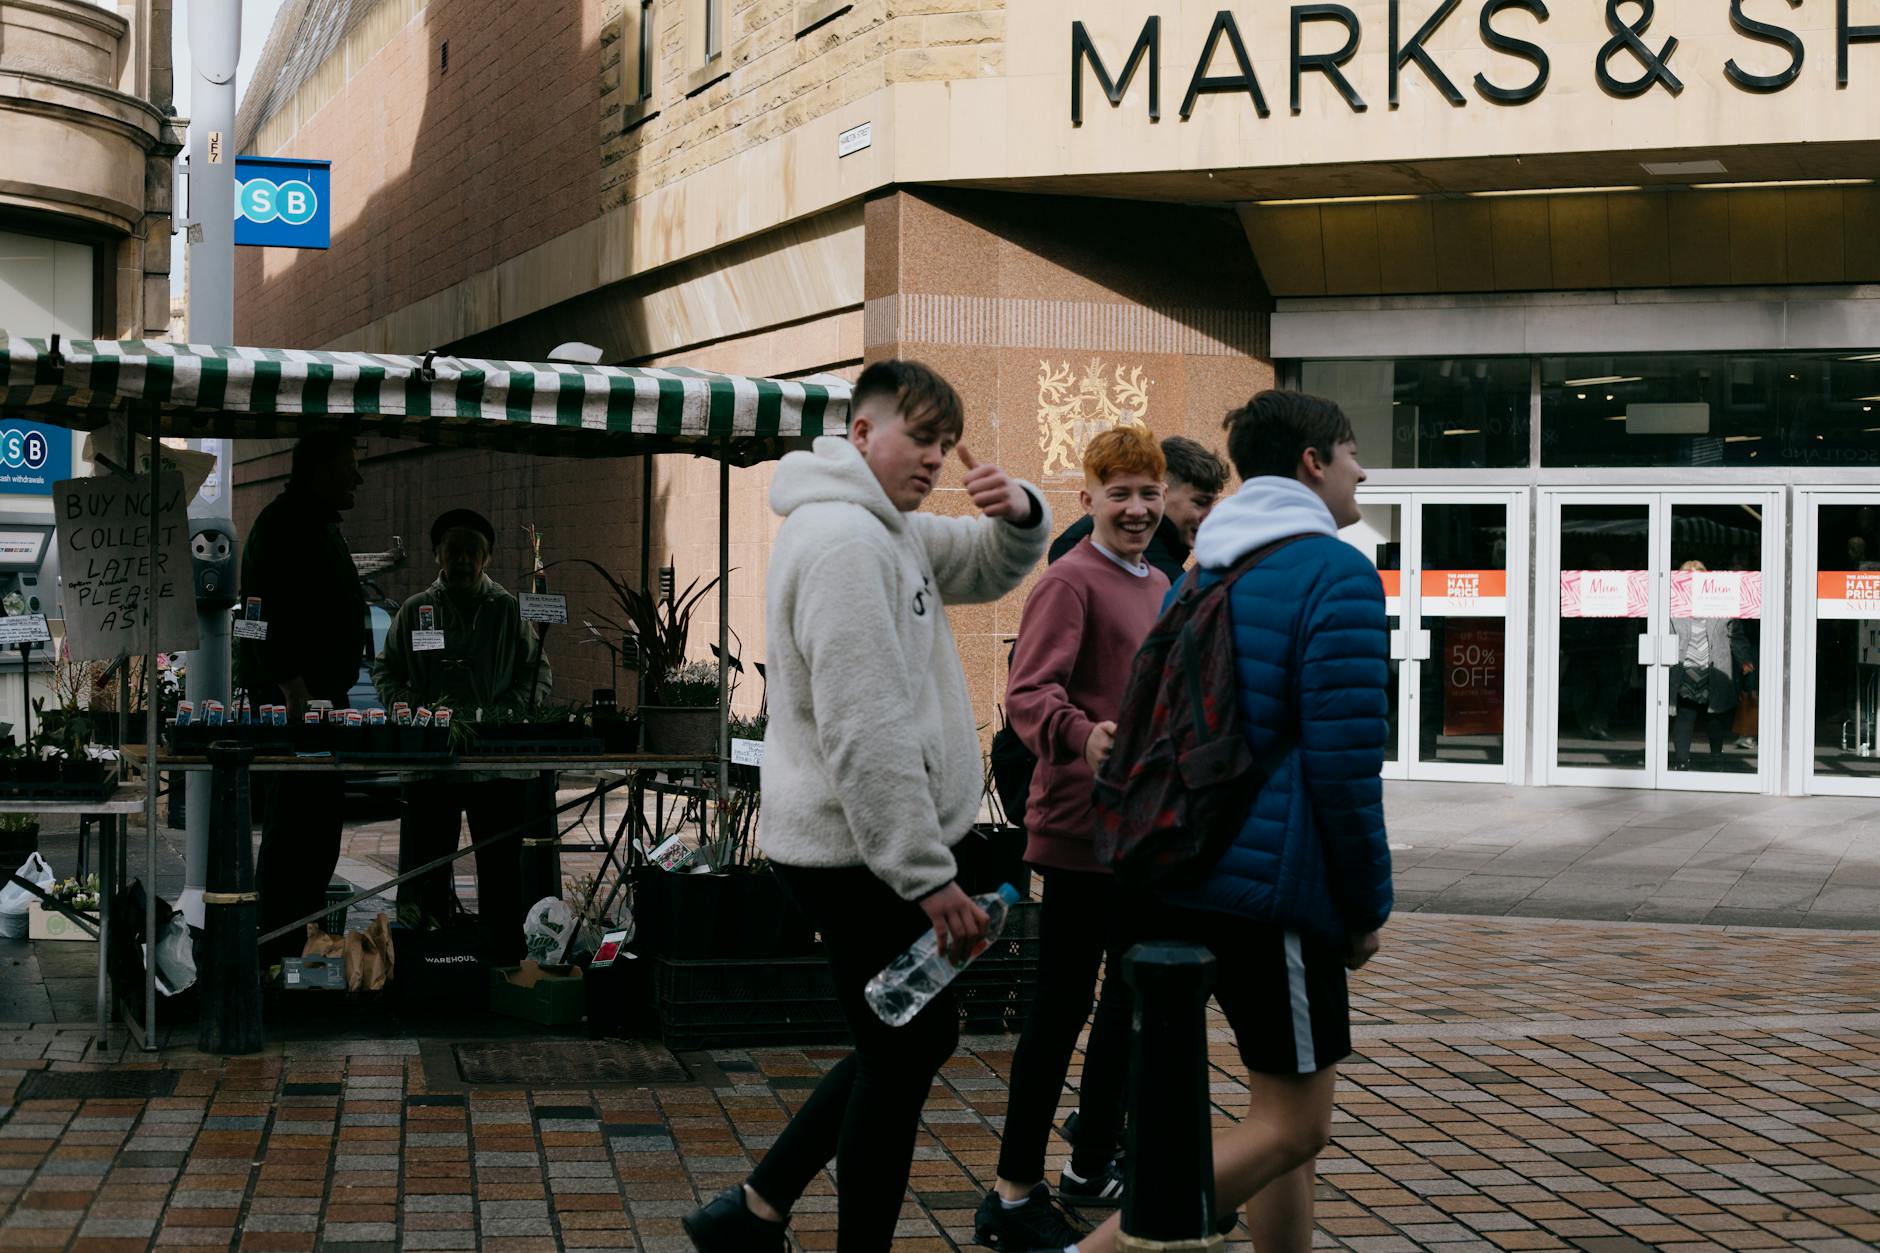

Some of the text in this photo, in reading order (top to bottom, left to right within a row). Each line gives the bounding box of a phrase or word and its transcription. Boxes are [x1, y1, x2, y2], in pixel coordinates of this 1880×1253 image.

[1071, 0, 1549, 128] MARKS
[1595, 0, 1684, 98] &
[251, 189, 306, 215] SB
[8, 437, 42, 461] SB
[12, 475, 45, 484] withdrawals
[67, 493, 115, 520] BUY
[70, 525, 178, 551] COLLET
[88, 553, 169, 579] LATER
[1448, 578, 1479, 588] HALF
[1448, 587, 1479, 597] PRICE
[1589, 578, 1619, 594] Mum
[1700, 578, 1732, 594] Mum
[1846, 580, 1880, 589] HALF
[1846, 589, 1880, 599] PRICE
[1452, 644, 1495, 666] 50%
[1451, 667, 1497, 688] OFF
